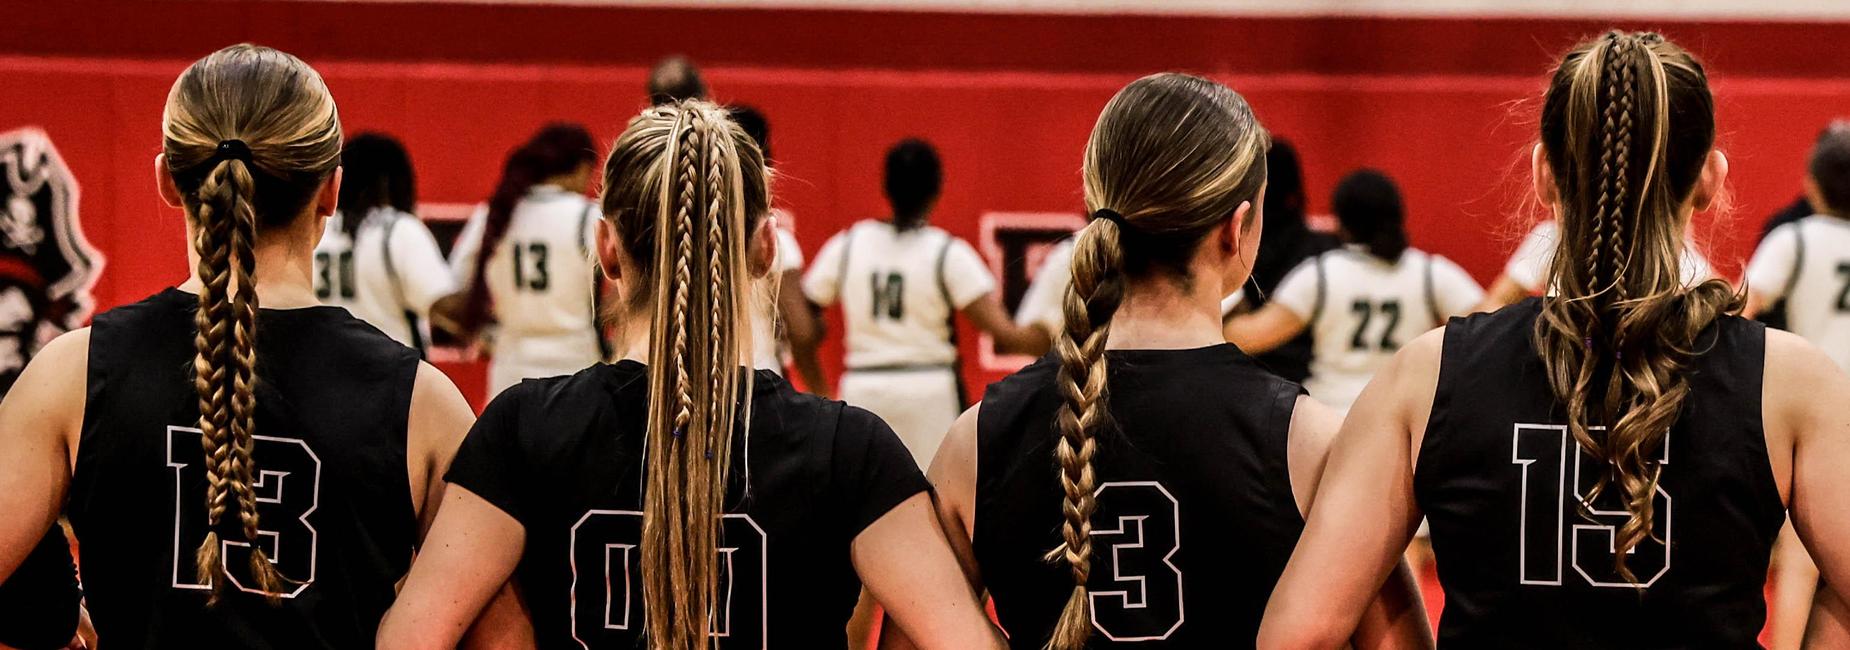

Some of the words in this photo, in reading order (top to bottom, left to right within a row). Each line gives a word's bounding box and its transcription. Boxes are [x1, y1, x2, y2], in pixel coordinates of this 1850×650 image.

[513, 242, 549, 291] 13
[1350, 300, 1401, 351] 22
[166, 425, 321, 599] 13
[1089, 481, 1185, 642] 3
[1512, 423, 1672, 588] 15
